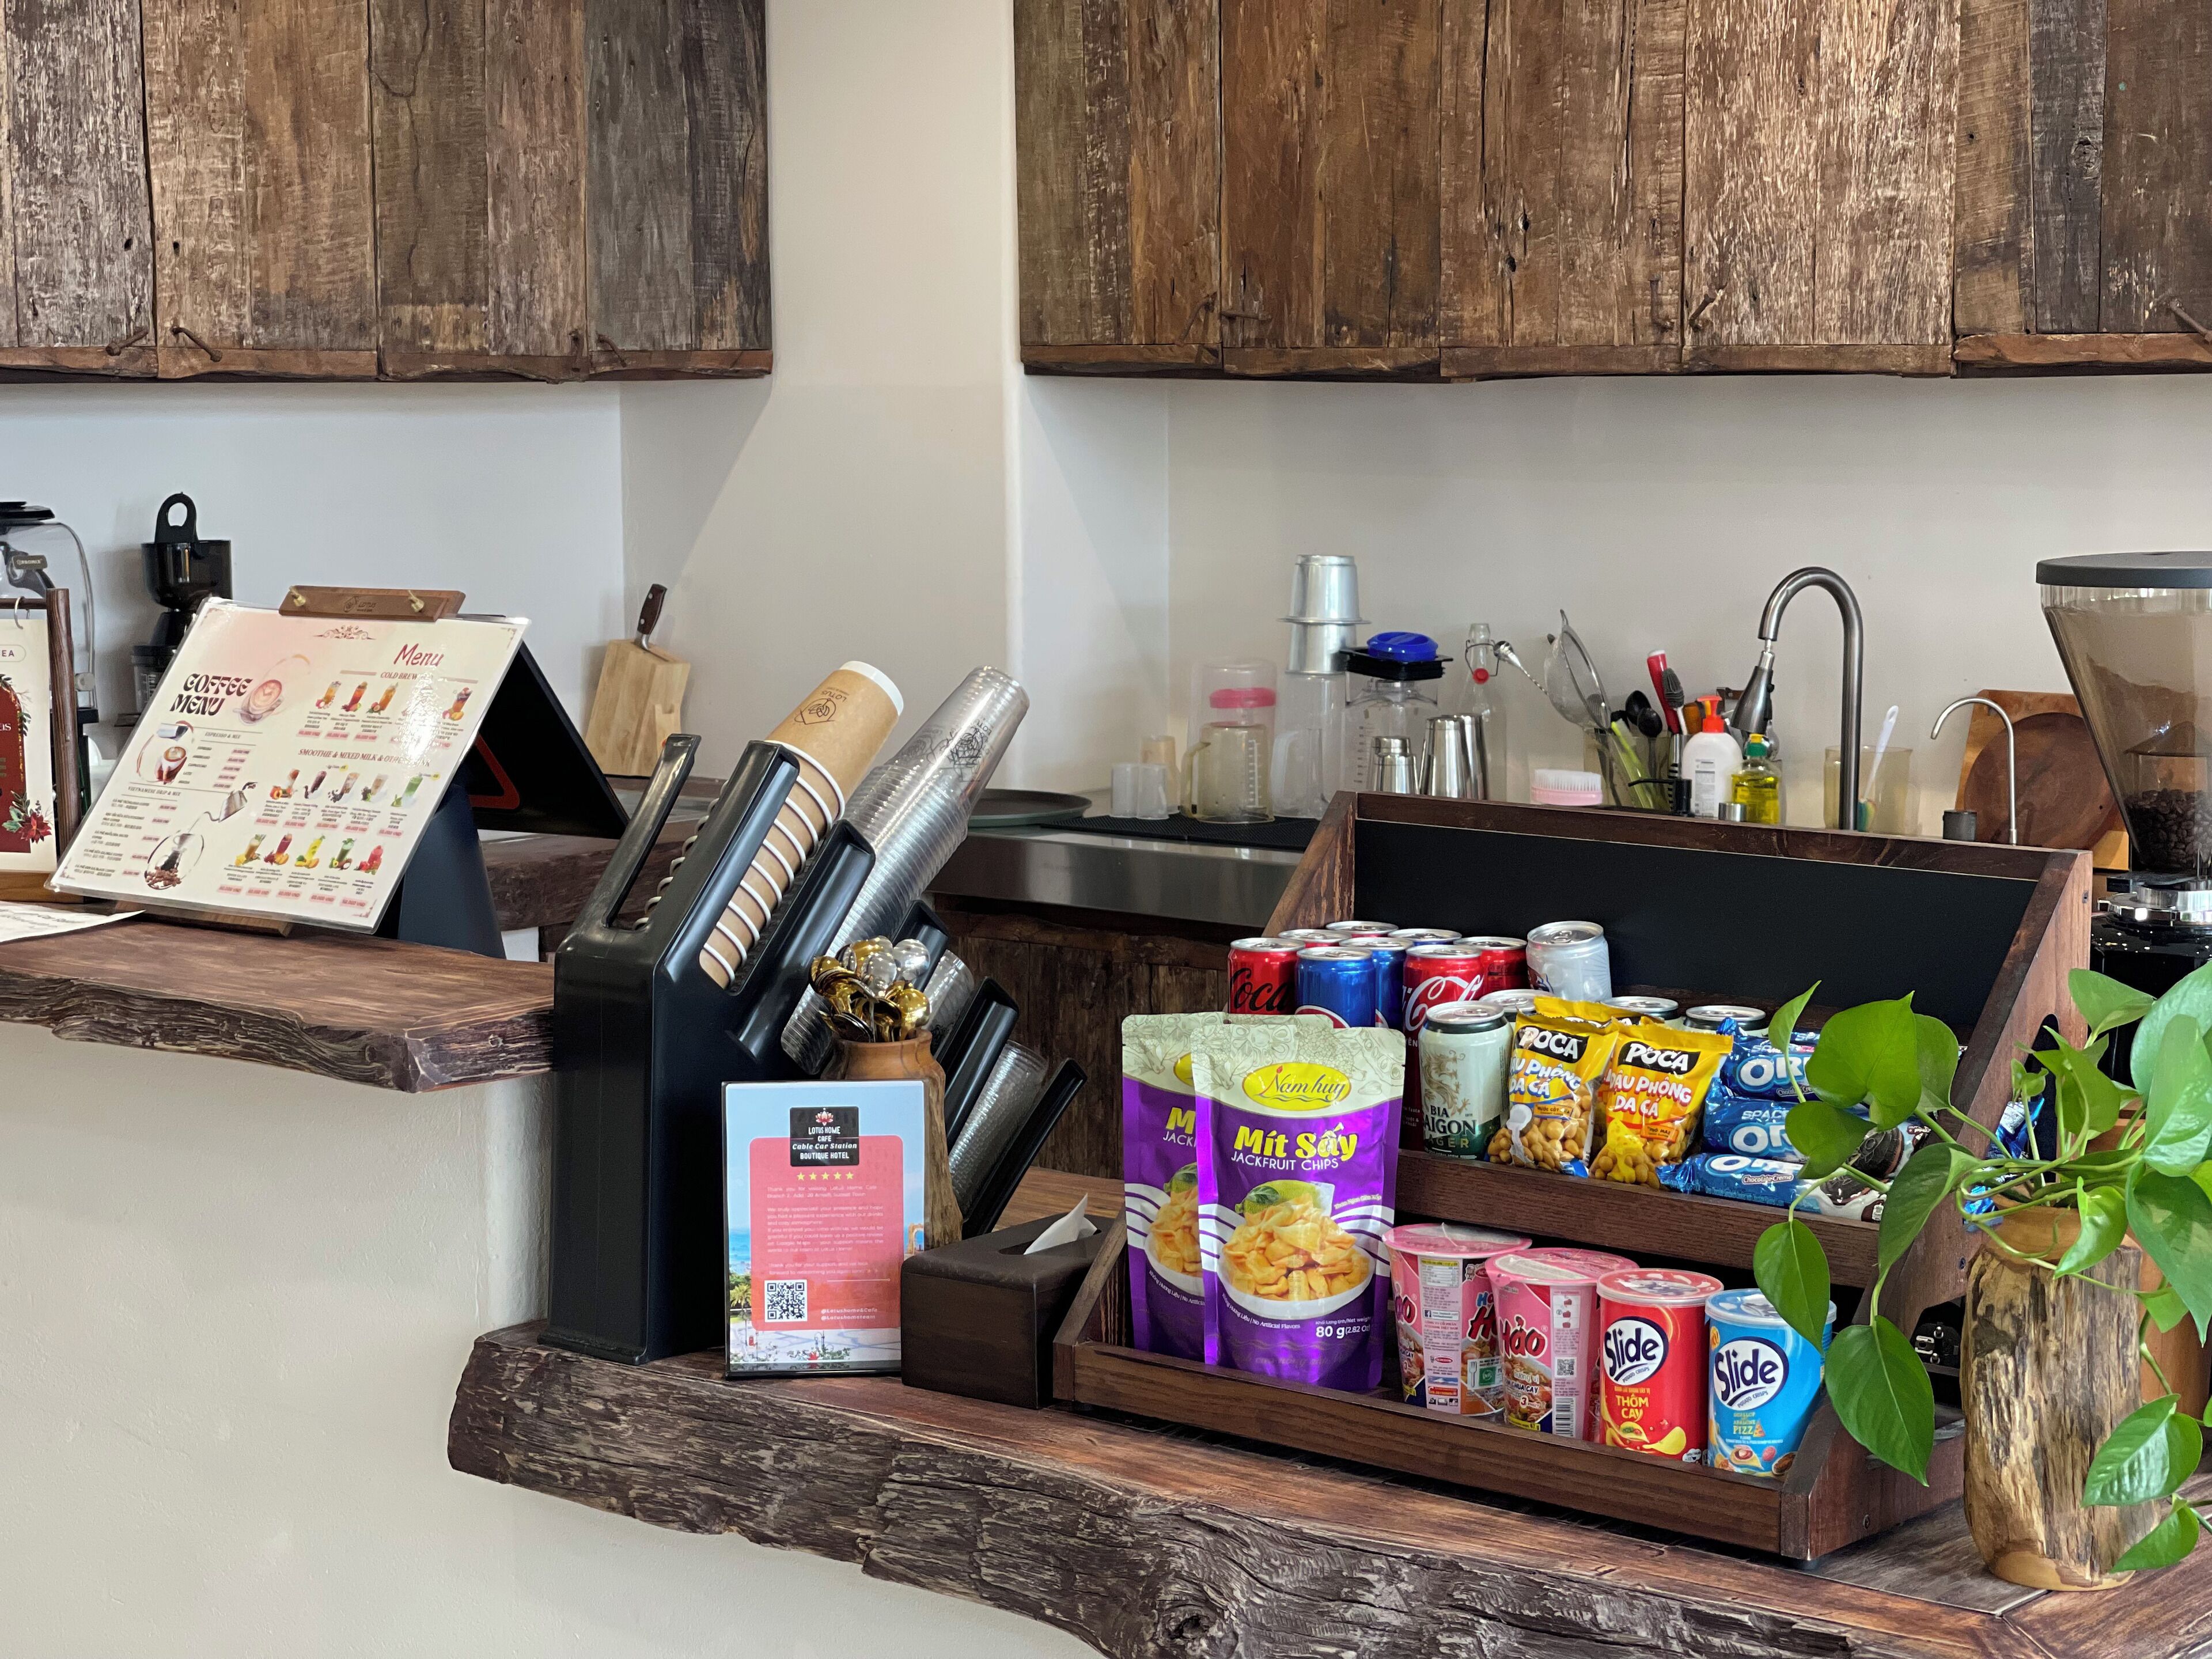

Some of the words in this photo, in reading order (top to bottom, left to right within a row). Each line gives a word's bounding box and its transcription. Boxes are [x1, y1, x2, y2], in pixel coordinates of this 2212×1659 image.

[393, 643, 444, 667] Menu
[183, 673, 253, 696] COFFEE
[398, 672, 419, 680] BREW
[169, 694, 225, 716] MENU
[821, 691, 847, 702] LOTUS
[298, 749, 332, 758] SMOOTHIE
[339, 752, 360, 760] MIXED
[1519, 1027, 1578, 1060] POCA
[1625, 1043, 1689, 1073] POCA
[1635, 1075, 1692, 1106] PHÔNG
[1430, 1105, 1449, 1118] BIA
[1614, 1094, 1637, 1115] DA
[1640, 1095, 1662, 1119] CÁ
[808, 1127, 824, 1135] LOTUS
[824, 1126, 840, 1134] HOME
[1425, 1115, 1477, 1135] AIGON
[1234, 1126, 1289, 1158] Mít
[1295, 1122, 1358, 1162] Sấy
[1428, 1134, 1469, 1148] AGER
[1230, 1152, 1296, 1171] JACKFRUIT
[1301, 1158, 1339, 1171] CHIPS
[1743, 1175, 1772, 1183] Chocolate
[1316, 1325, 1333, 1338] 80
[1336, 1327, 1345, 1339] g
[1604, 1328, 1659, 1377] Slide
[1622, 1372, 1635, 1383] POTATO
[1636, 1366, 1650, 1374] CRISPS
[1715, 1349, 1779, 1402] Slide
[1526, 1386, 1539, 1394] CAY
[1521, 1397, 1527, 1406] 3
[1737, 1396, 1752, 1408] POTATO
[1752, 1391, 1768, 1399] CRISPS
[1622, 1408, 1643, 1422] CAY
